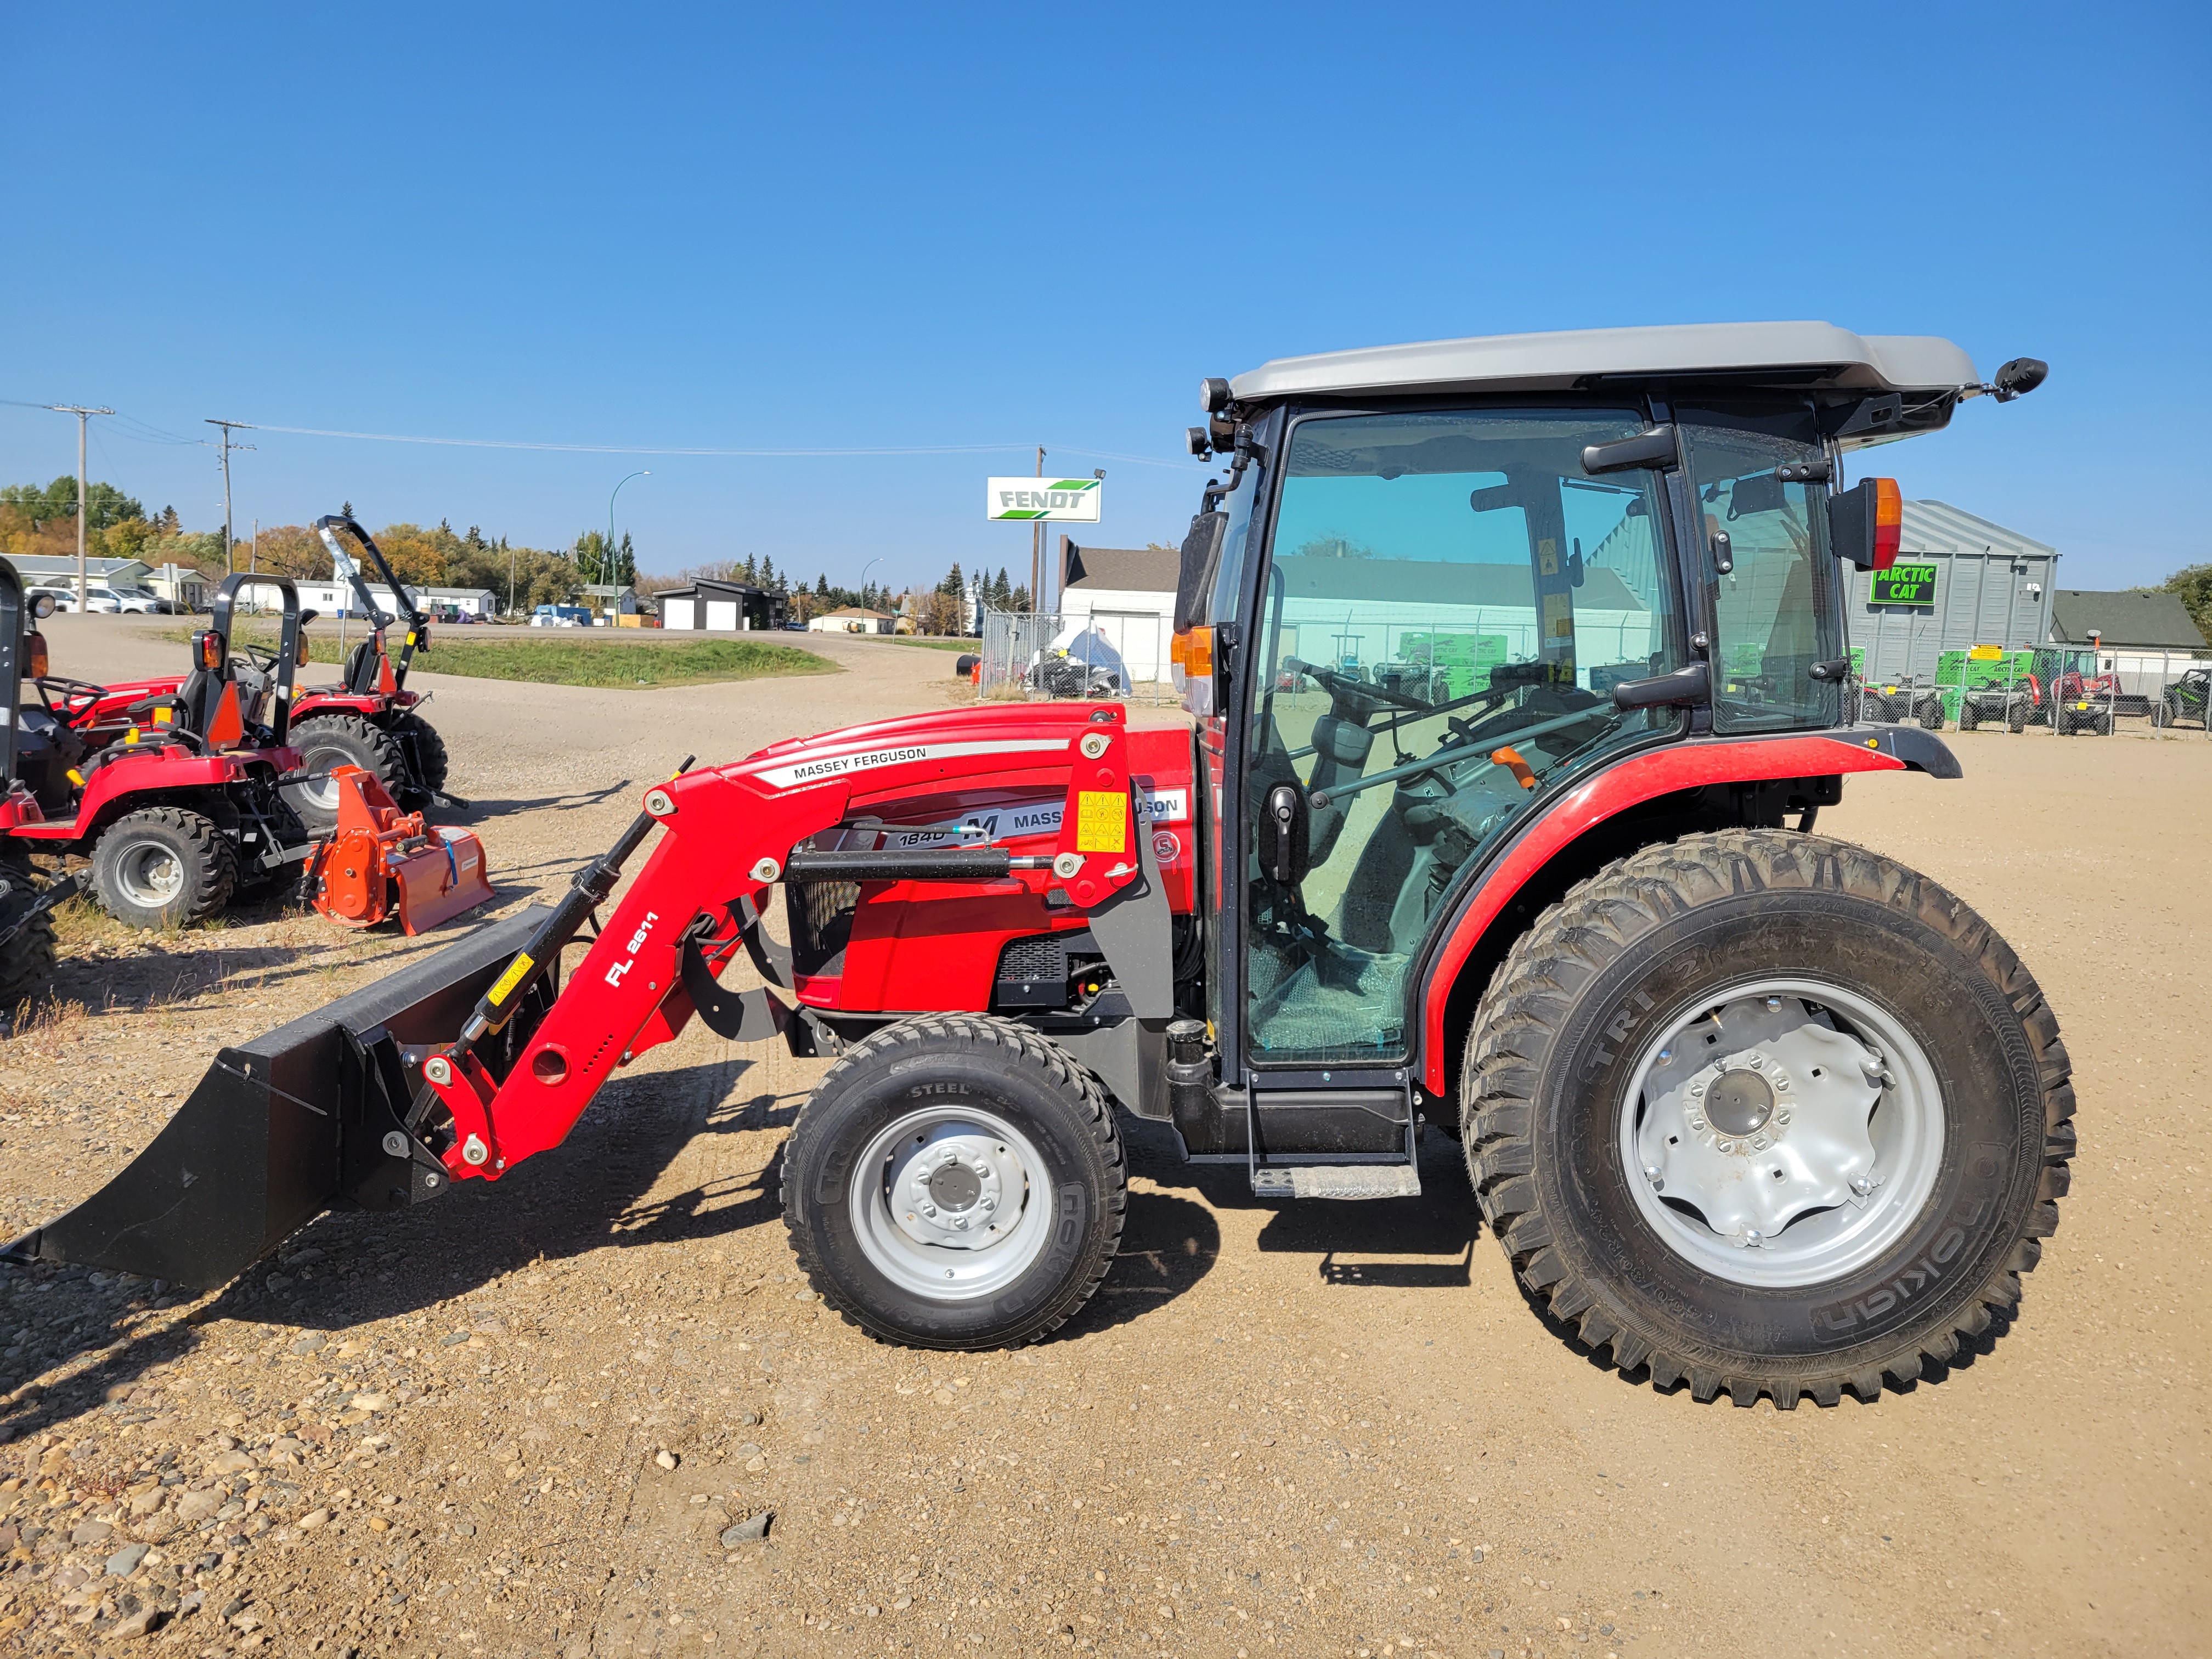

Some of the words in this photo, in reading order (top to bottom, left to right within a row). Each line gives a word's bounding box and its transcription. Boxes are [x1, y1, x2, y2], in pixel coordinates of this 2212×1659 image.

[999, 491, 1086, 509] FENDT
[1877, 567, 1934, 583] ARCTIC
[1889, 583, 1920, 599] CAT
[794, 759, 849, 778] MASSEY
[854, 748, 927, 767] FERGUSON
[1014, 810, 1064, 829] MASS
[1799, 898, 1883, 921] ROTATION
[605, 959, 634, 988] FL
[627, 911, 659, 955] 2611
[1589, 989, 1656, 1070] TRI
[1674, 958, 1701, 980] 2
[910, 1082, 970, 1098] STEEL
[820, 1137, 850, 1193] TRI
